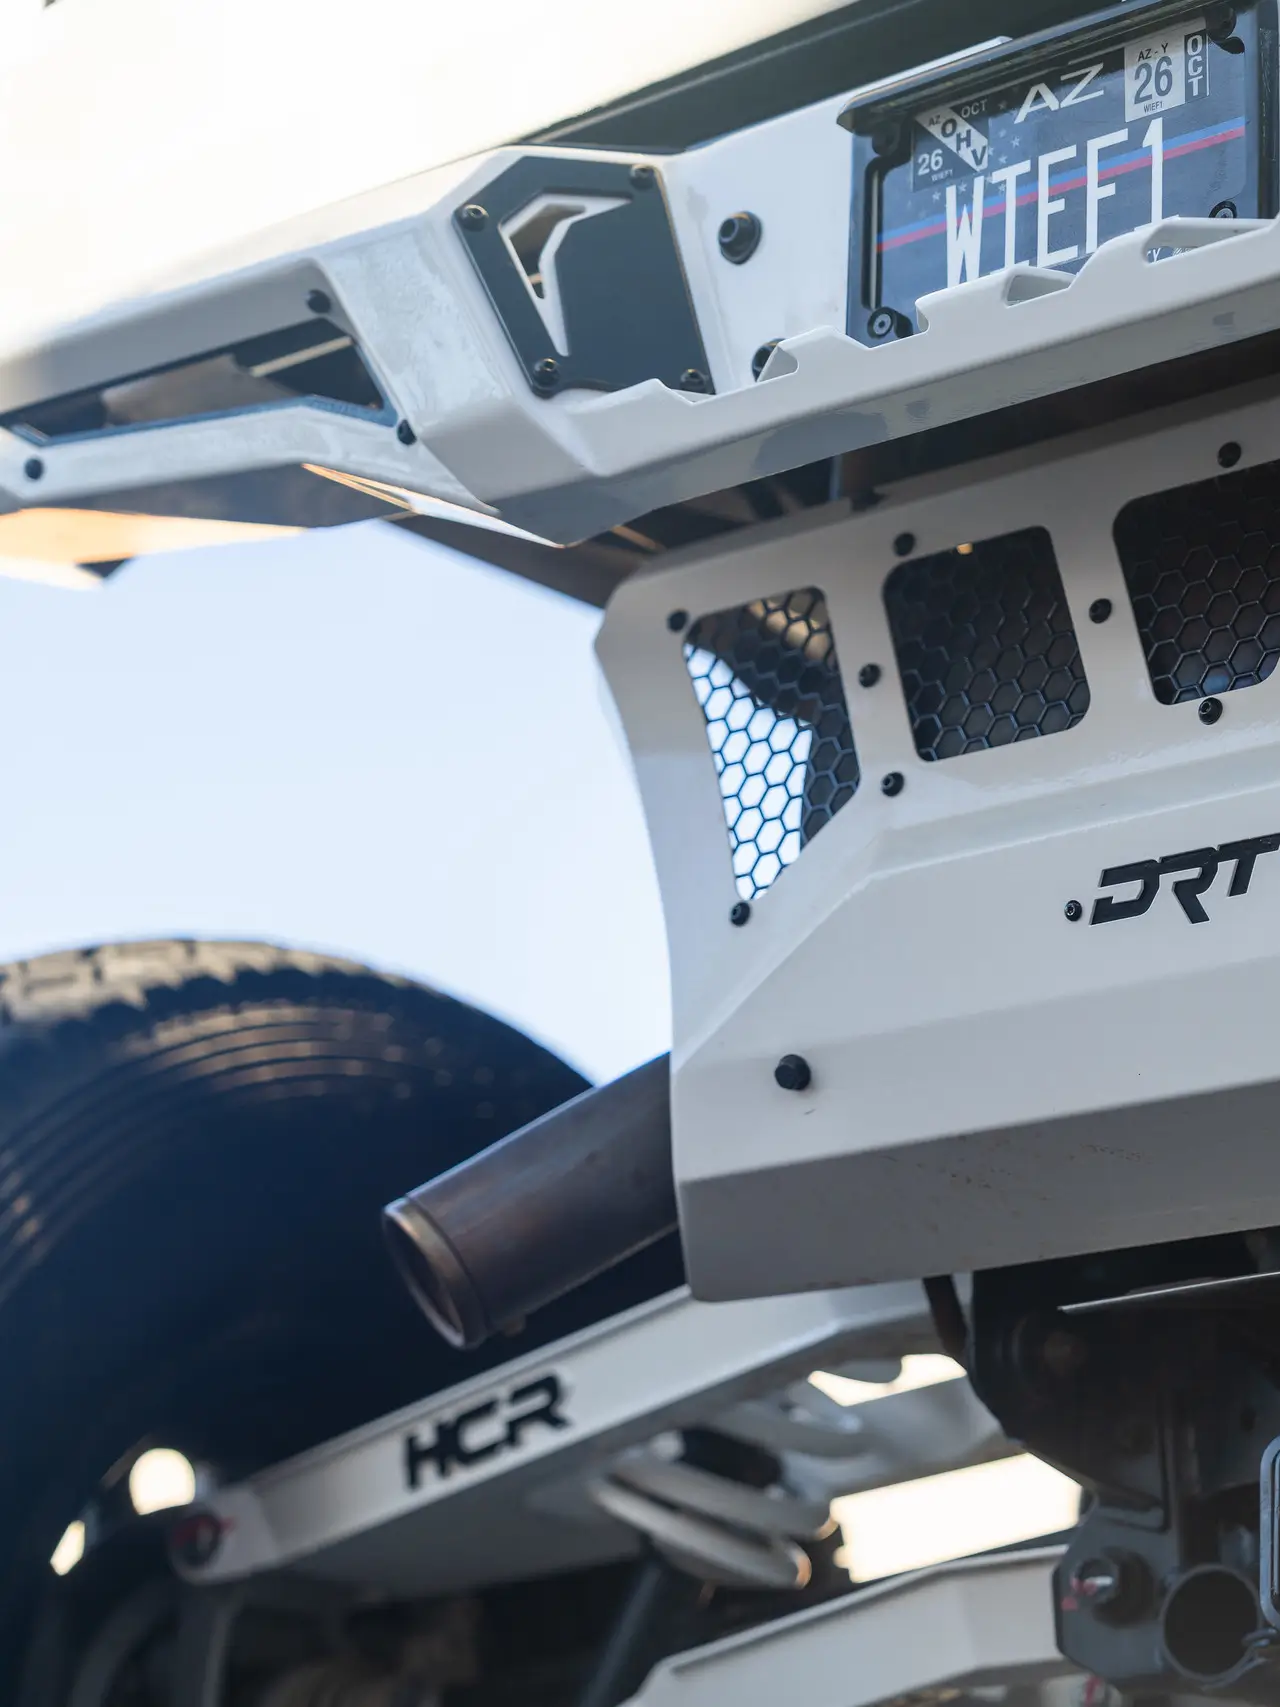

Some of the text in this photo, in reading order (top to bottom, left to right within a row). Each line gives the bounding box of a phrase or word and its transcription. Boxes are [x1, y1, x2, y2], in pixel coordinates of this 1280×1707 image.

[1134, 55, 1173, 105] 26
[1187, 35, 1204, 96] OCT
[961, 99, 988, 118] OCT
[1014, 62, 1104, 124] AZ
[1143, 101, 1164, 113] WIEF1
[918, 148, 943, 176] 26
[406, 1374, 571, 1489] HCR
